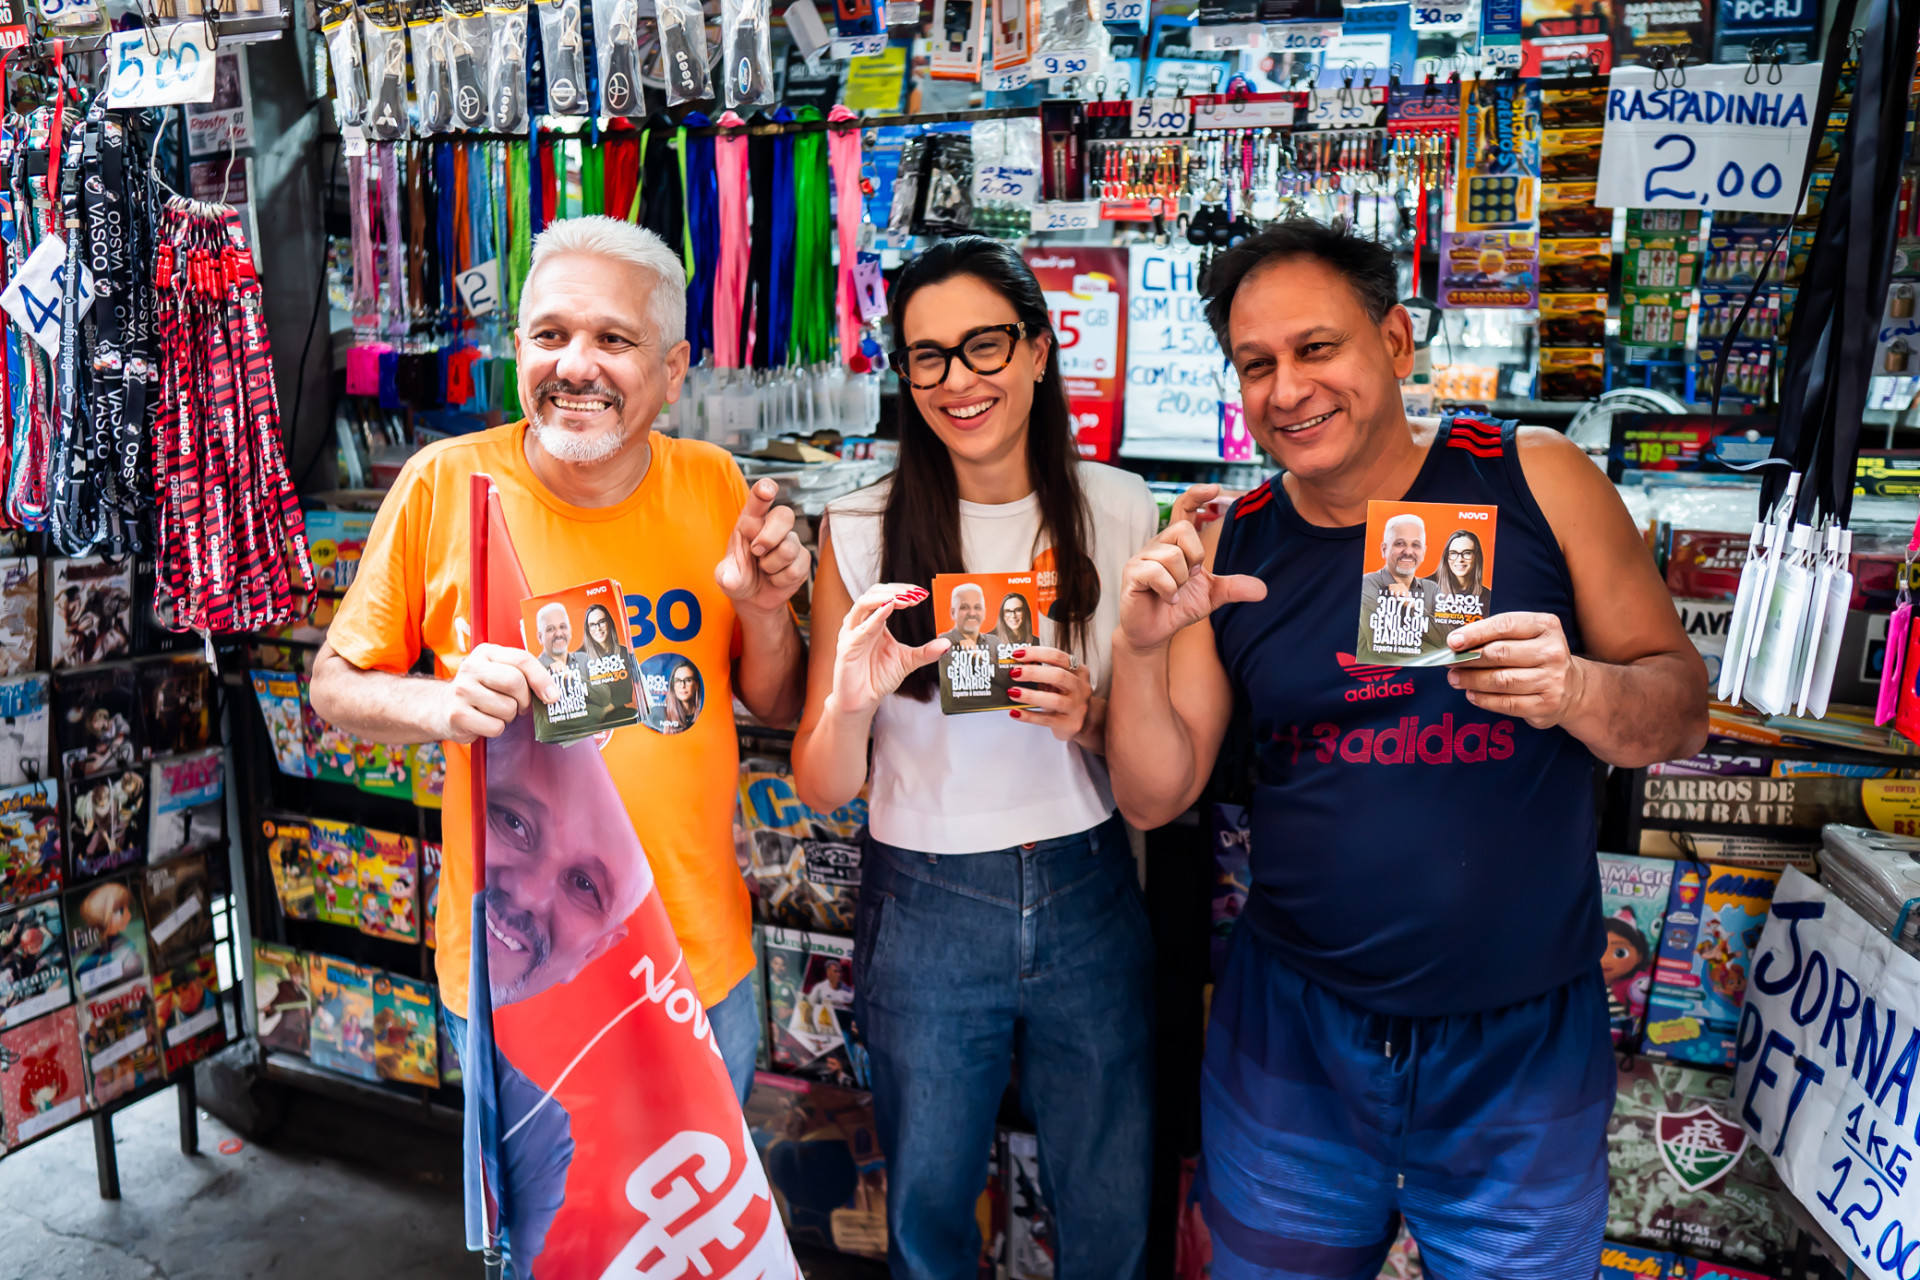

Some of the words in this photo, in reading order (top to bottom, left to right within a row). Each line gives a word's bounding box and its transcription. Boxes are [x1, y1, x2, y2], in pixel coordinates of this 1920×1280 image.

[1104, 2, 1142, 19] 5,00
[676, 51, 695, 91] Jeep
[498, 86, 512, 124] Jeep
[1137, 105, 1185, 129] 5,00
[1607, 88, 1808, 128] RASPADINHA
[1511, 98, 1526, 153] SHOW
[1643, 133, 1783, 206] 2,00
[64, 230, 79, 281] Botafogo
[88, 201, 108, 271] VASCO
[107, 210, 124, 271] VASCO
[137, 284, 149, 343] VASCO
[243, 290, 259, 351] FLAMENO
[1050, 309, 1081, 350] 5
[1084, 309, 1109, 326] GB
[61, 318, 78, 371] Botafogo
[96, 395, 110, 459] VASCO
[180, 391, 191, 455] FLAMENGO
[223, 408, 235, 468] FLAMENGO
[157, 425, 166, 488] FLAMENGO
[258, 415, 272, 474] FLAMENGO
[272, 434, 291, 492] FLAMENGO
[122, 442, 140, 507] VASCO
[170, 474, 180, 533] FLAMENGO
[1458, 511, 1489, 521] NOVO
[187, 521, 201, 585] FLAMENGO
[210, 534, 222, 595] FLAMENGO
[294, 534, 313, 590] FLAMENGO
[586, 585, 607, 597] NOVO
[1376, 596, 1425, 618] 30779
[1434, 593, 1484, 607] CAROL
[1434, 604, 1483, 616] SPONZA
[624, 588, 702, 649] 30
[1369, 613, 1429, 634] GENILSON
[1373, 630, 1423, 646] BARROS
[587, 654, 625, 671] CAROL
[589, 663, 626, 678] SPONZA
[612, 669, 629, 682] 30
[947, 664, 996, 680] GENILSON
[951, 650, 991, 667] 30779
[550, 668, 581, 691] 0779
[952, 676, 991, 691] BARROS
[1344, 680, 1415, 703] adidas
[548, 697, 587, 716] BARROS
[659, 720, 679, 728] NOVO
[1644, 779, 1753, 801] CARROS
[1759, 781, 1795, 803] DE
[1642, 801, 1794, 826] COMBATE
[72, 927, 100, 950] Fate
[629, 954, 723, 1060] NOV
[1754, 901, 1920, 1147] JORNA
[1730, 1001, 1826, 1158] PET
